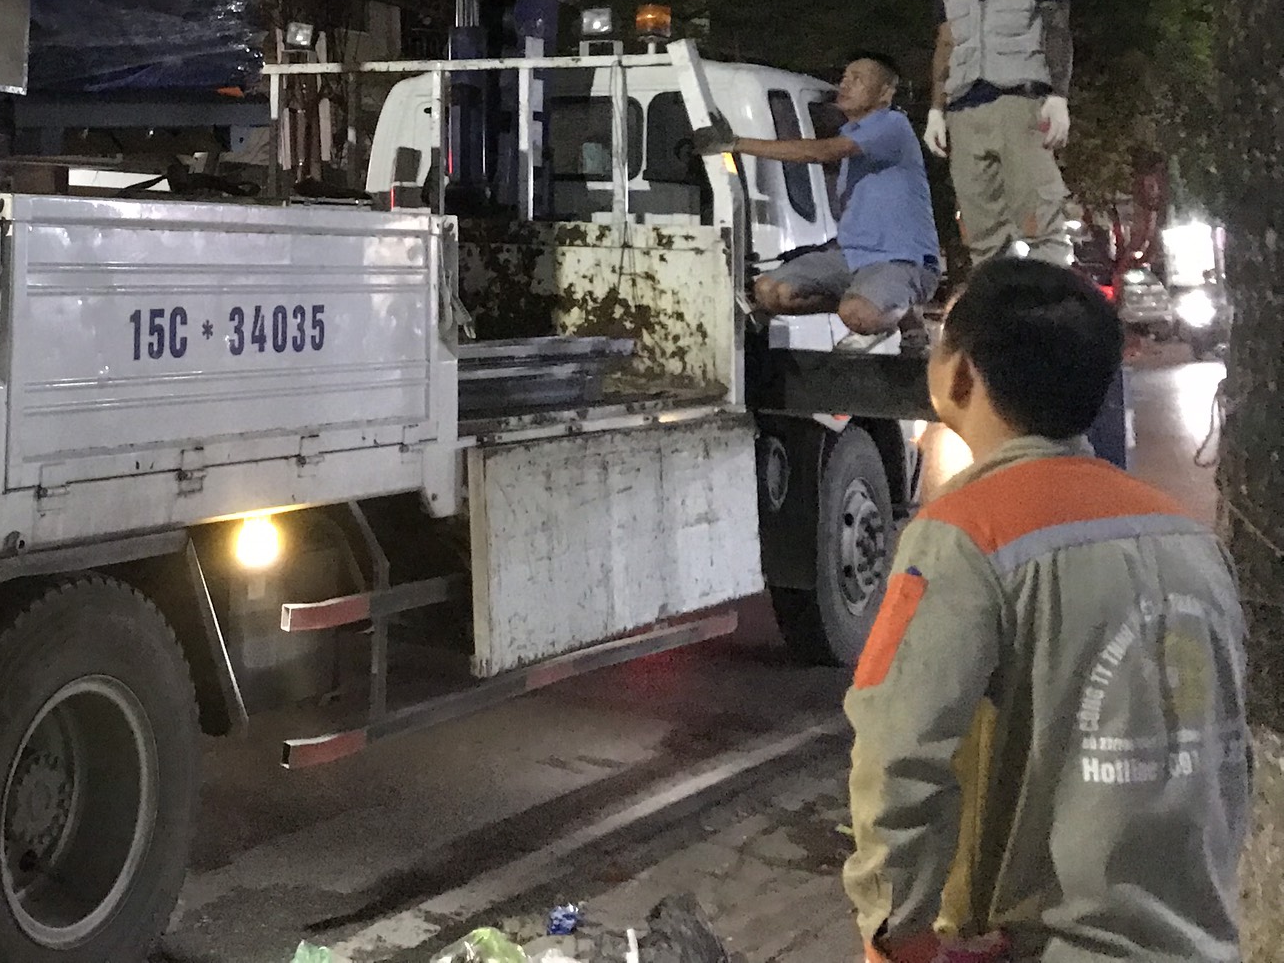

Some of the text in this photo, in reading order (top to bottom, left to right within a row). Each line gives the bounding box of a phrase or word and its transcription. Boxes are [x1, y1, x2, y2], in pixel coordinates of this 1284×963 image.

[129, 304, 325, 361] 15C 34035
[1082, 756, 1157, 783] Hotl
